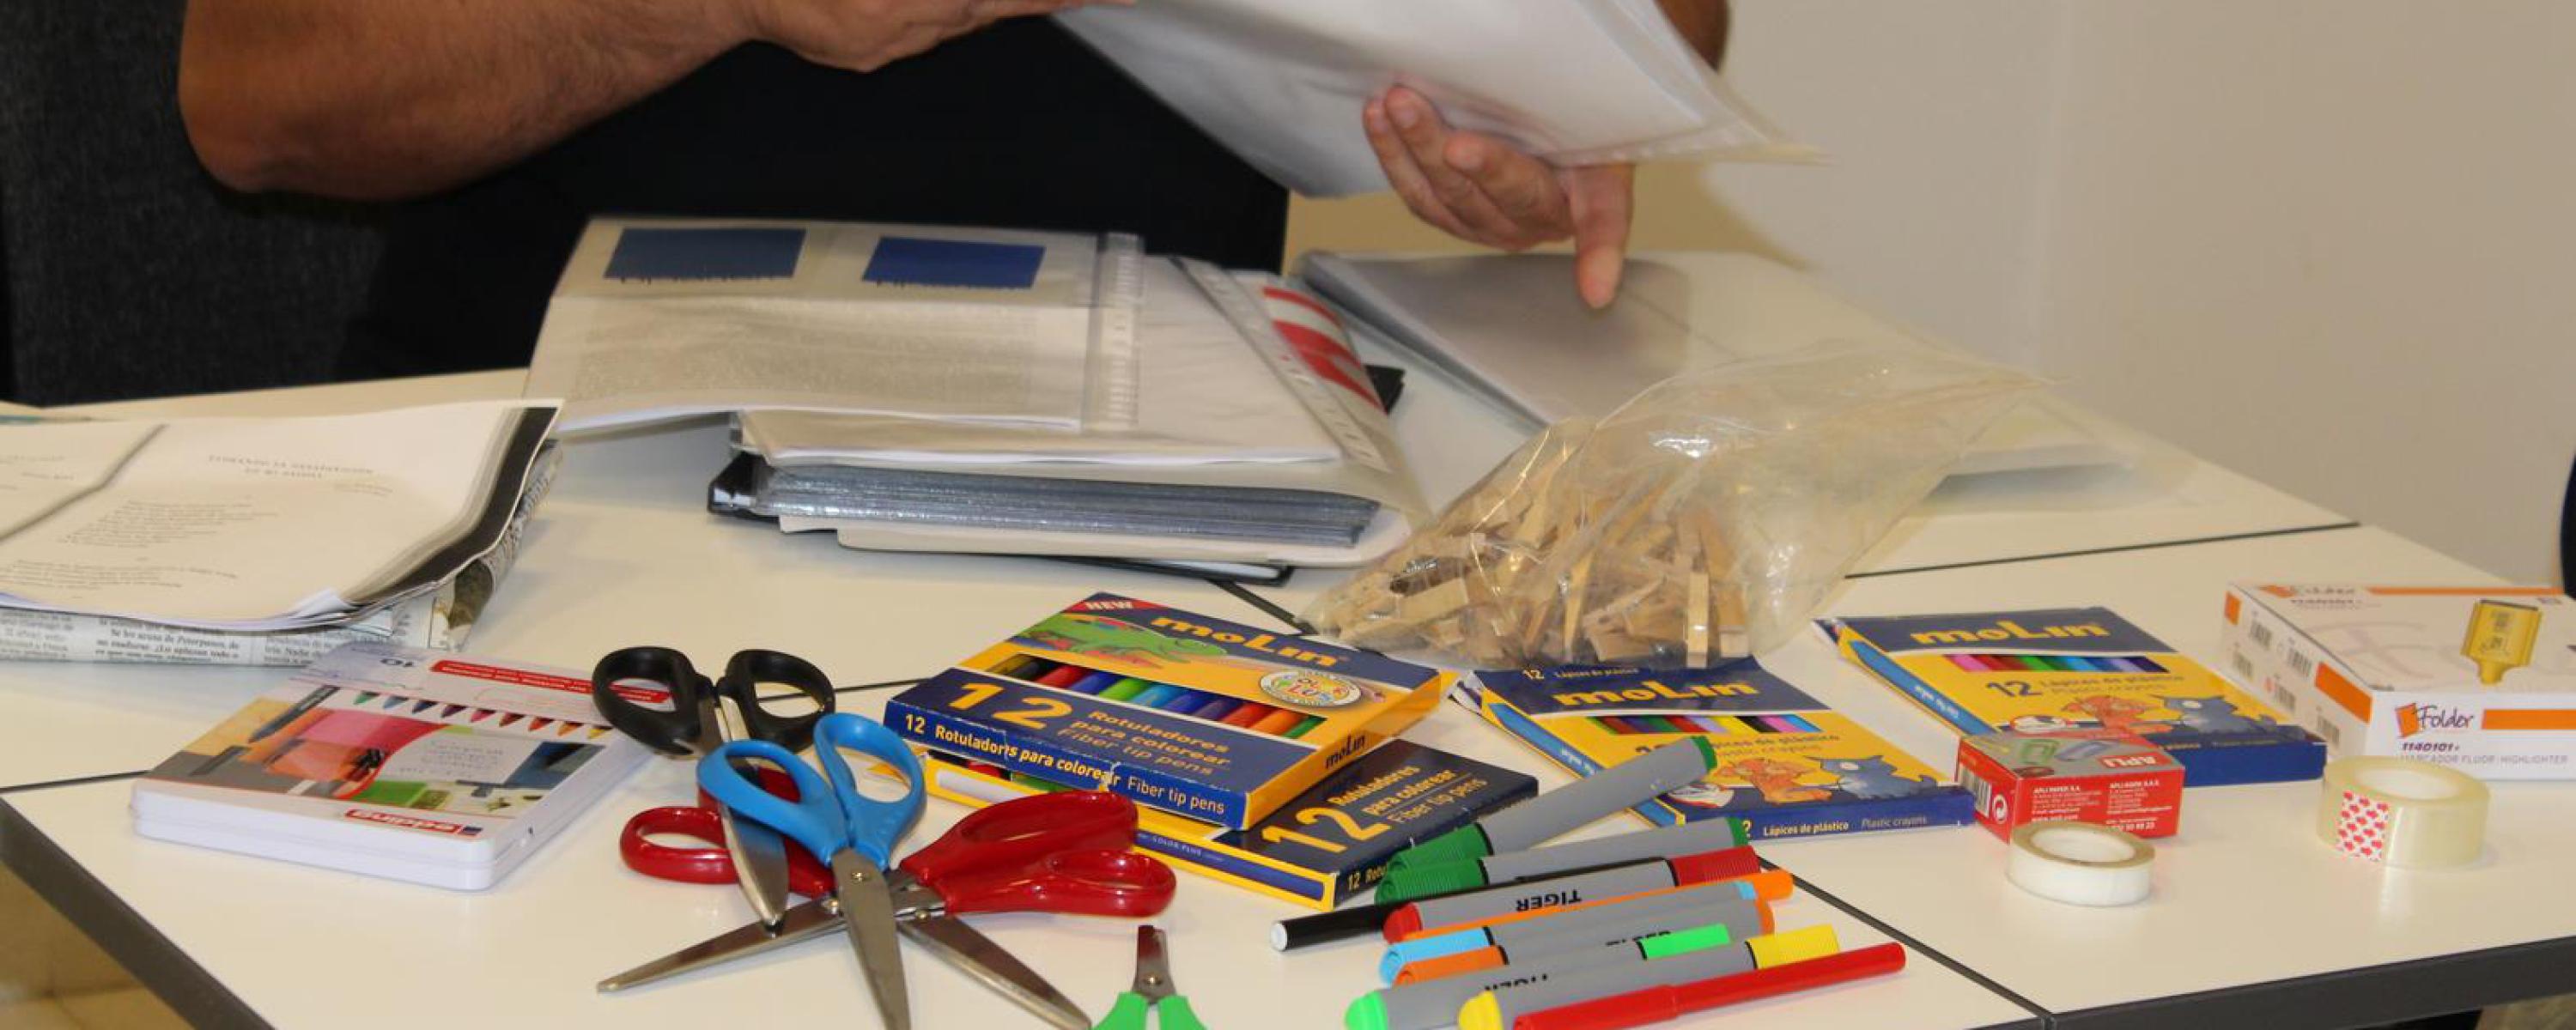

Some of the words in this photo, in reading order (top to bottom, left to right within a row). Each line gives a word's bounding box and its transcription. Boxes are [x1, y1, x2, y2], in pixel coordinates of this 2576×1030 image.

[1085, 601, 1133, 610] NEW
[947, 682, 1072, 730] 12
[1986, 680, 2043, 698] 12
[1088, 711, 1230, 754] Rotuladores
[2415, 704, 2474, 730] Folder
[905, 713, 927, 735] 12
[1018, 748, 1054, 768] para
[1127, 775, 1165, 797] Fiber
[1169, 787, 1187, 807] tip
[1190, 796, 1226, 815] pens
[1057, 727, 1119, 749] Fiber
[1123, 745, 1153, 759] tip
[1154, 755, 1214, 776] pens
[1071, 721, 1127, 740] para
[1131, 735, 1231, 766] colorear
[1327, 765, 1421, 807] Rotuladores
[1361, 797, 1402, 816] para
[1396, 769, 1458, 799] colorear
[1387, 803, 1433, 824] Fiber
[1449, 778, 1488, 799] pens
[1261, 807, 1394, 854] 12
[1763, 826, 1799, 837] Lápices
[1801, 823, 1812, 834] de
[1347, 871, 1361, 891] 12
[1516, 888, 1583, 912] TIGER
